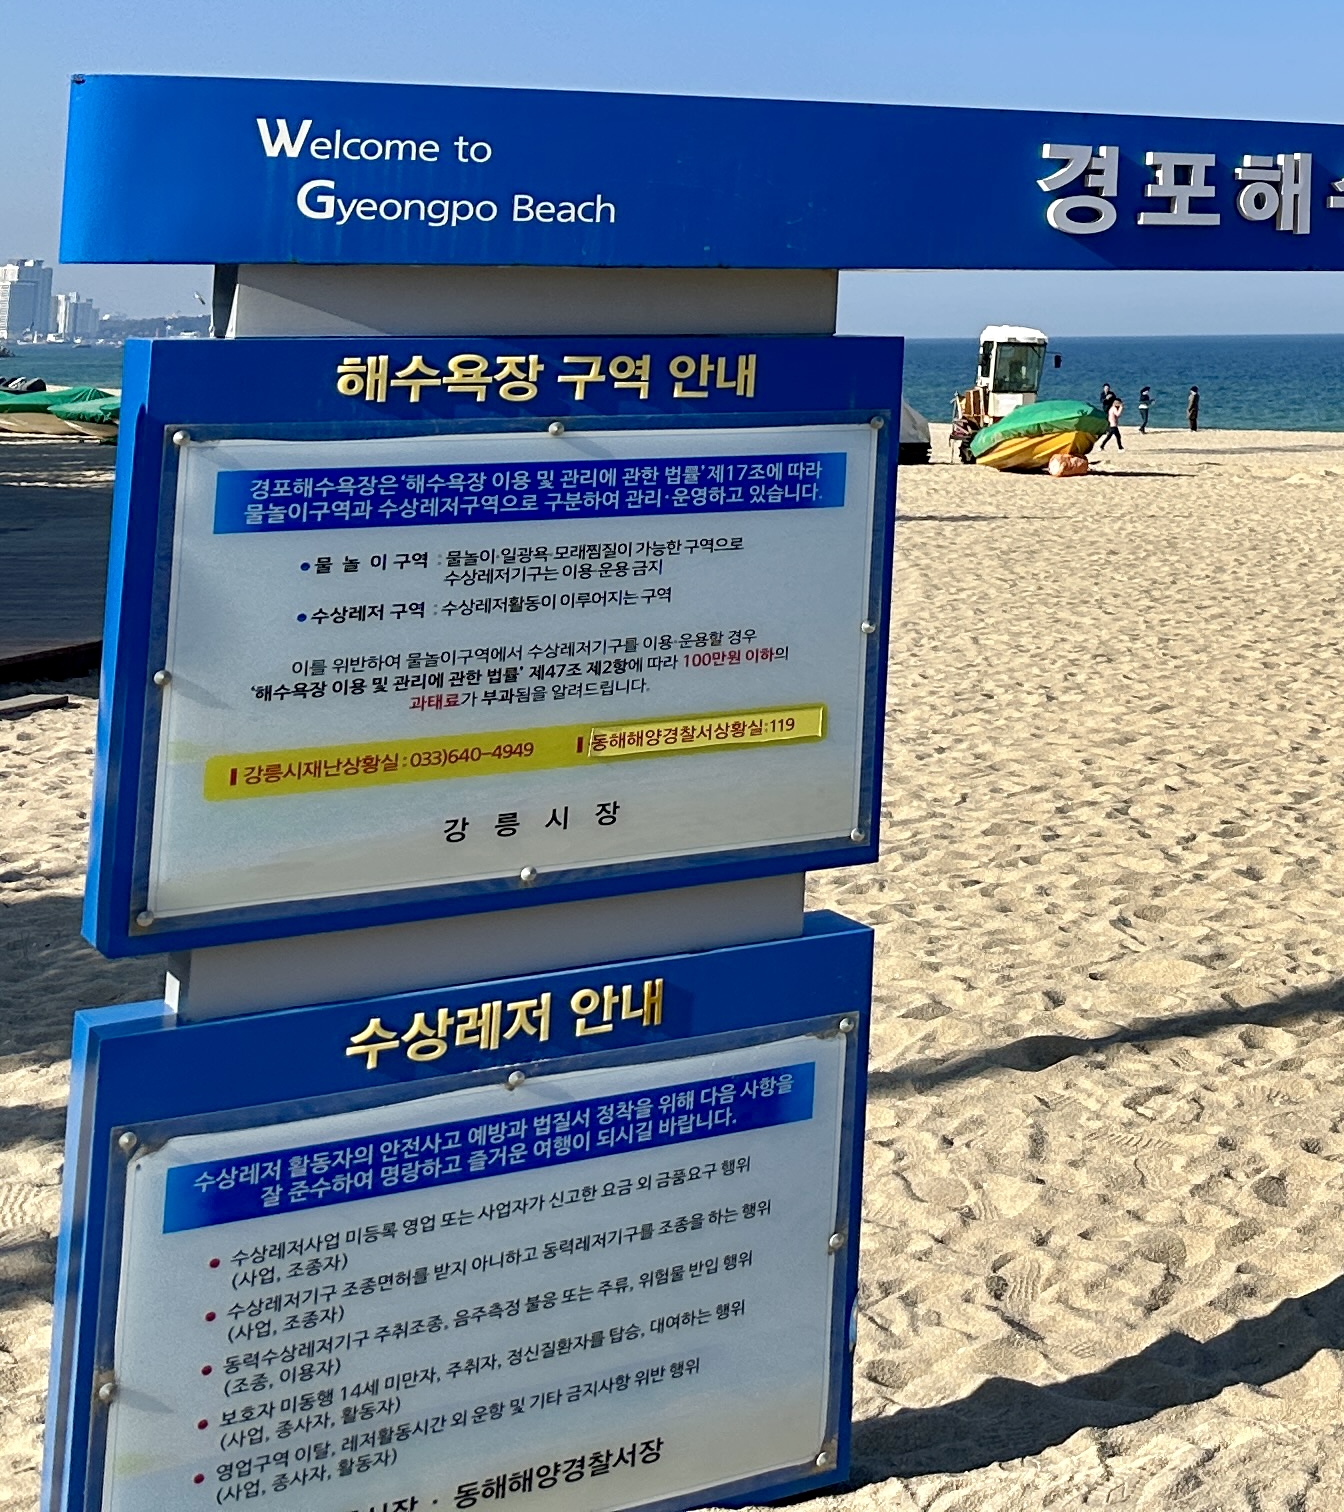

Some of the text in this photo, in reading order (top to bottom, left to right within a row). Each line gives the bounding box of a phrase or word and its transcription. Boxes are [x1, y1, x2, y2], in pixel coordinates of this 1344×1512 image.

[256, 118, 492, 163] Welcome to
[297, 179, 617, 226] Gyeongpo Beach
[336, 353, 758, 403] 해수욕장 구역 안내
[245, 500, 372, 525] 물놀이구역과
[377, 495, 538, 520] 수상레저구역으로
[544, 491, 619, 512] 구분하여
[750, 483, 823, 503] 있습니다.
[251, 475, 398, 500] 경포해수욕장은
[492, 471, 531, 490] 이용
[537, 471, 554, 489] 및
[560, 467, 617, 488] 관리에
[622, 466, 659, 487] 관한
[708, 462, 783, 483] 제17조에
[787, 461, 822, 480] 따라
[393, 553, 428, 569] 구역
[636, 537, 744, 557] 가능한 구역으로
[444, 559, 663, 586] 수상레저기구는 금지
[311, 601, 425, 625] 수상레저 구역
[442, 587, 672, 617] 수상레저활동이 이루어지는 구역
[293, 628, 757, 677] 이를 위반하여 물놀이구역에서 수상레저기구를 경우
[529, 646, 789, 680] 제47조 제2항에 따라 100만원 이하의
[481, 685, 548, 705] 부과됨을
[346, 978, 664, 1070] 수상레저 안내
[194, 1074, 795, 1193] 수상레저 활동자의 안전사고 예방과 법질서 정착을 위해 다음 사항을
[262, 1108, 737, 1208] 잘 준수하여 명랑하고 즐거운 여행이 되시길 바랍니다.
[230, 1185, 597, 1267] 수상레저사업 미등록 영업 또는 사업자가 신고한
[228, 1246, 539, 1321] 수상레저기구 조종면허를 아니하고
[222, 1299, 521, 1375] 동력수상레저기구 음주측정
[219, 1378, 379, 1429] 보호자 14세
[453, 1436, 665, 1509] 동해해양경찰서장
